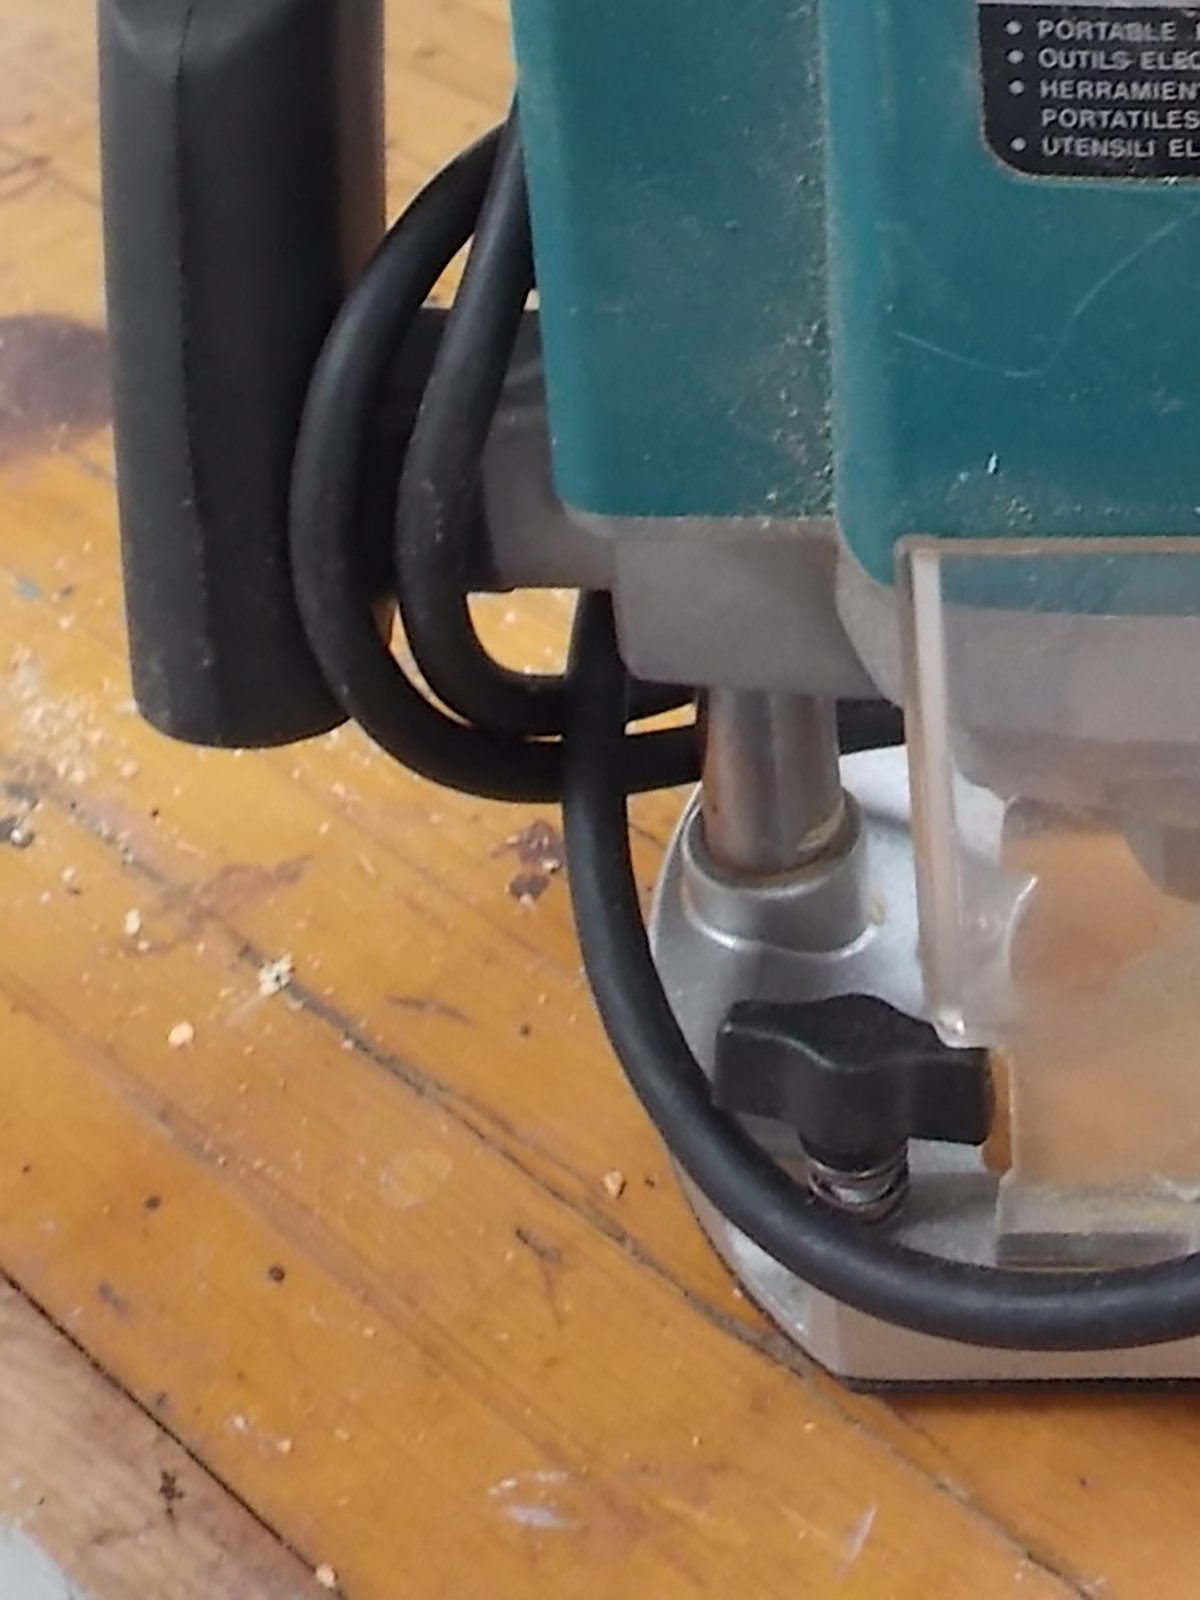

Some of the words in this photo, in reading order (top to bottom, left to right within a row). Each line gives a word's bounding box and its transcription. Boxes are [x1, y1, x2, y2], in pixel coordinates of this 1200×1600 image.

[1037, 18, 1177, 41] PORTABLE
[1038, 48, 1132, 70] OUTILS
[1041, 107, 1200, 130] PORTATILES
[1042, 136, 1155, 158] UTENSILI
